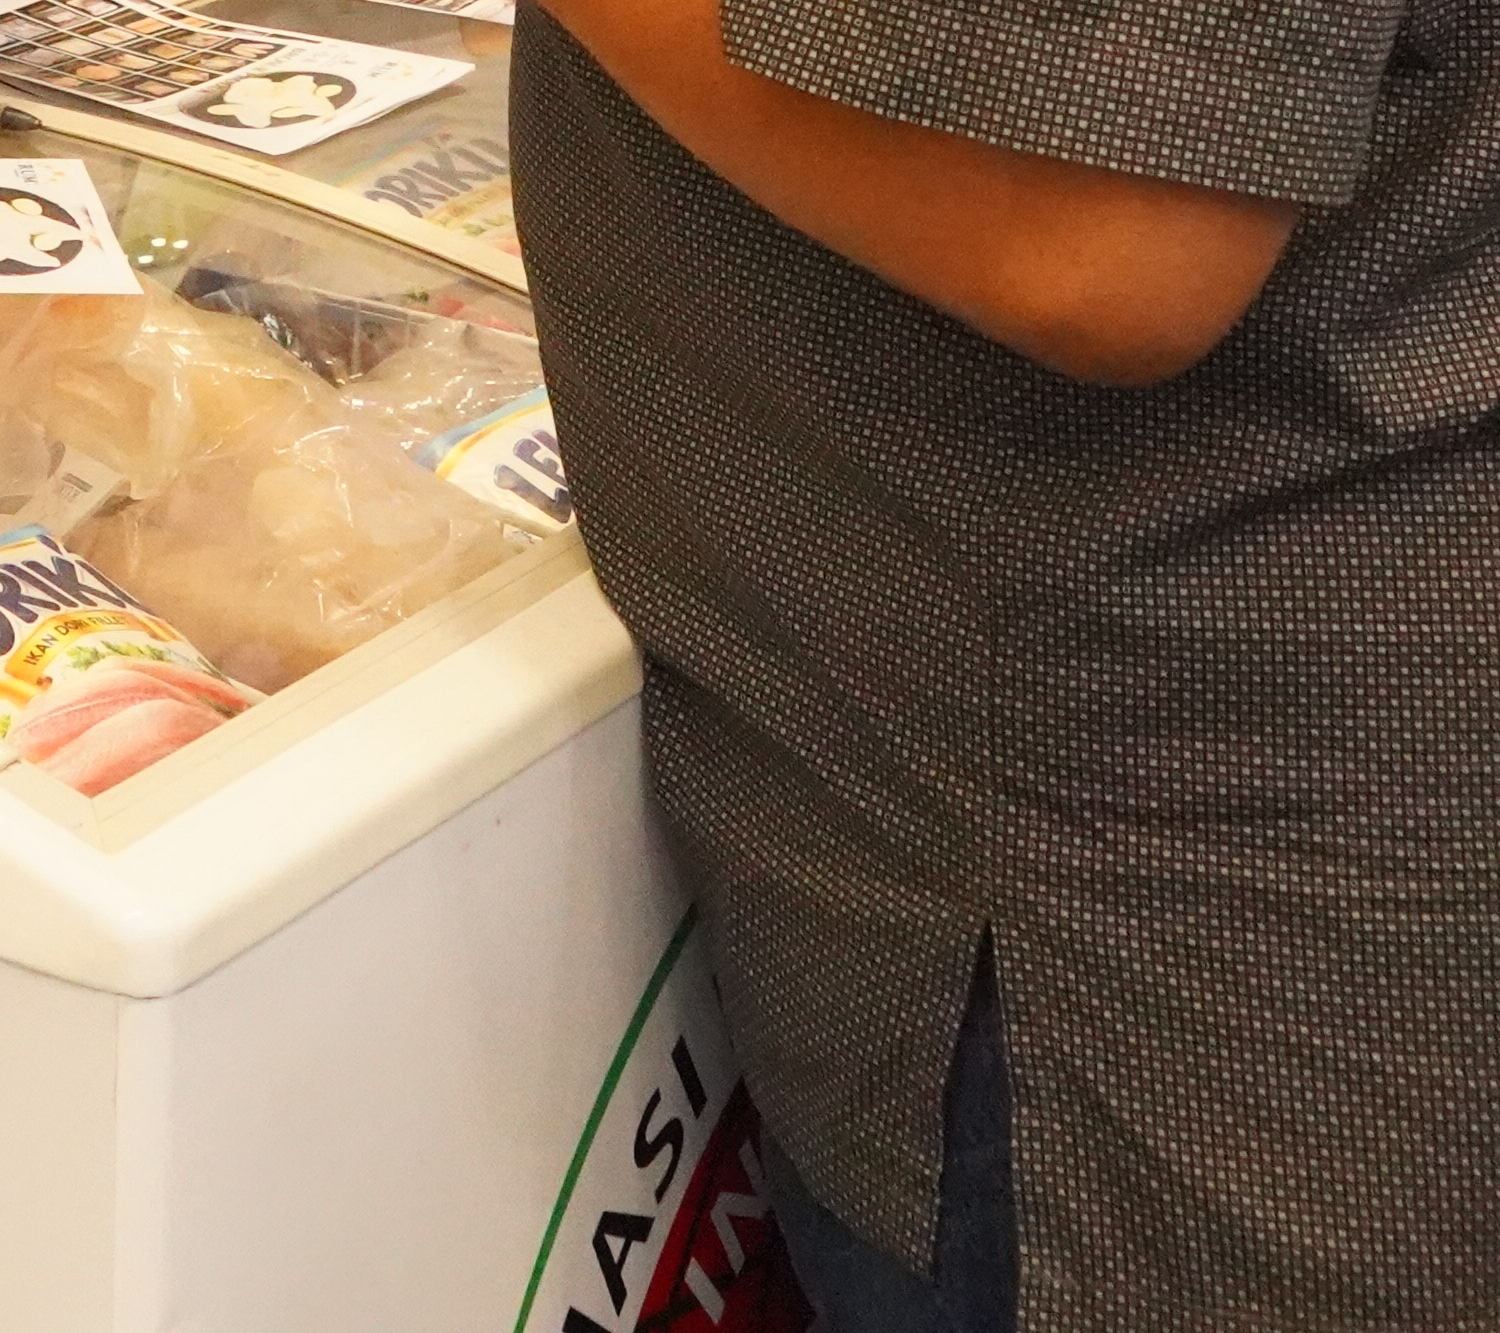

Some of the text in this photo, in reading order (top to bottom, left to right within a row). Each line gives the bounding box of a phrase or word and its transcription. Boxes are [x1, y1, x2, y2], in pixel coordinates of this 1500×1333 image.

[23, 633, 59, 666] IKAN
[54, 619, 90, 636] DORI
[562, 1035, 708, 1333] ASI
